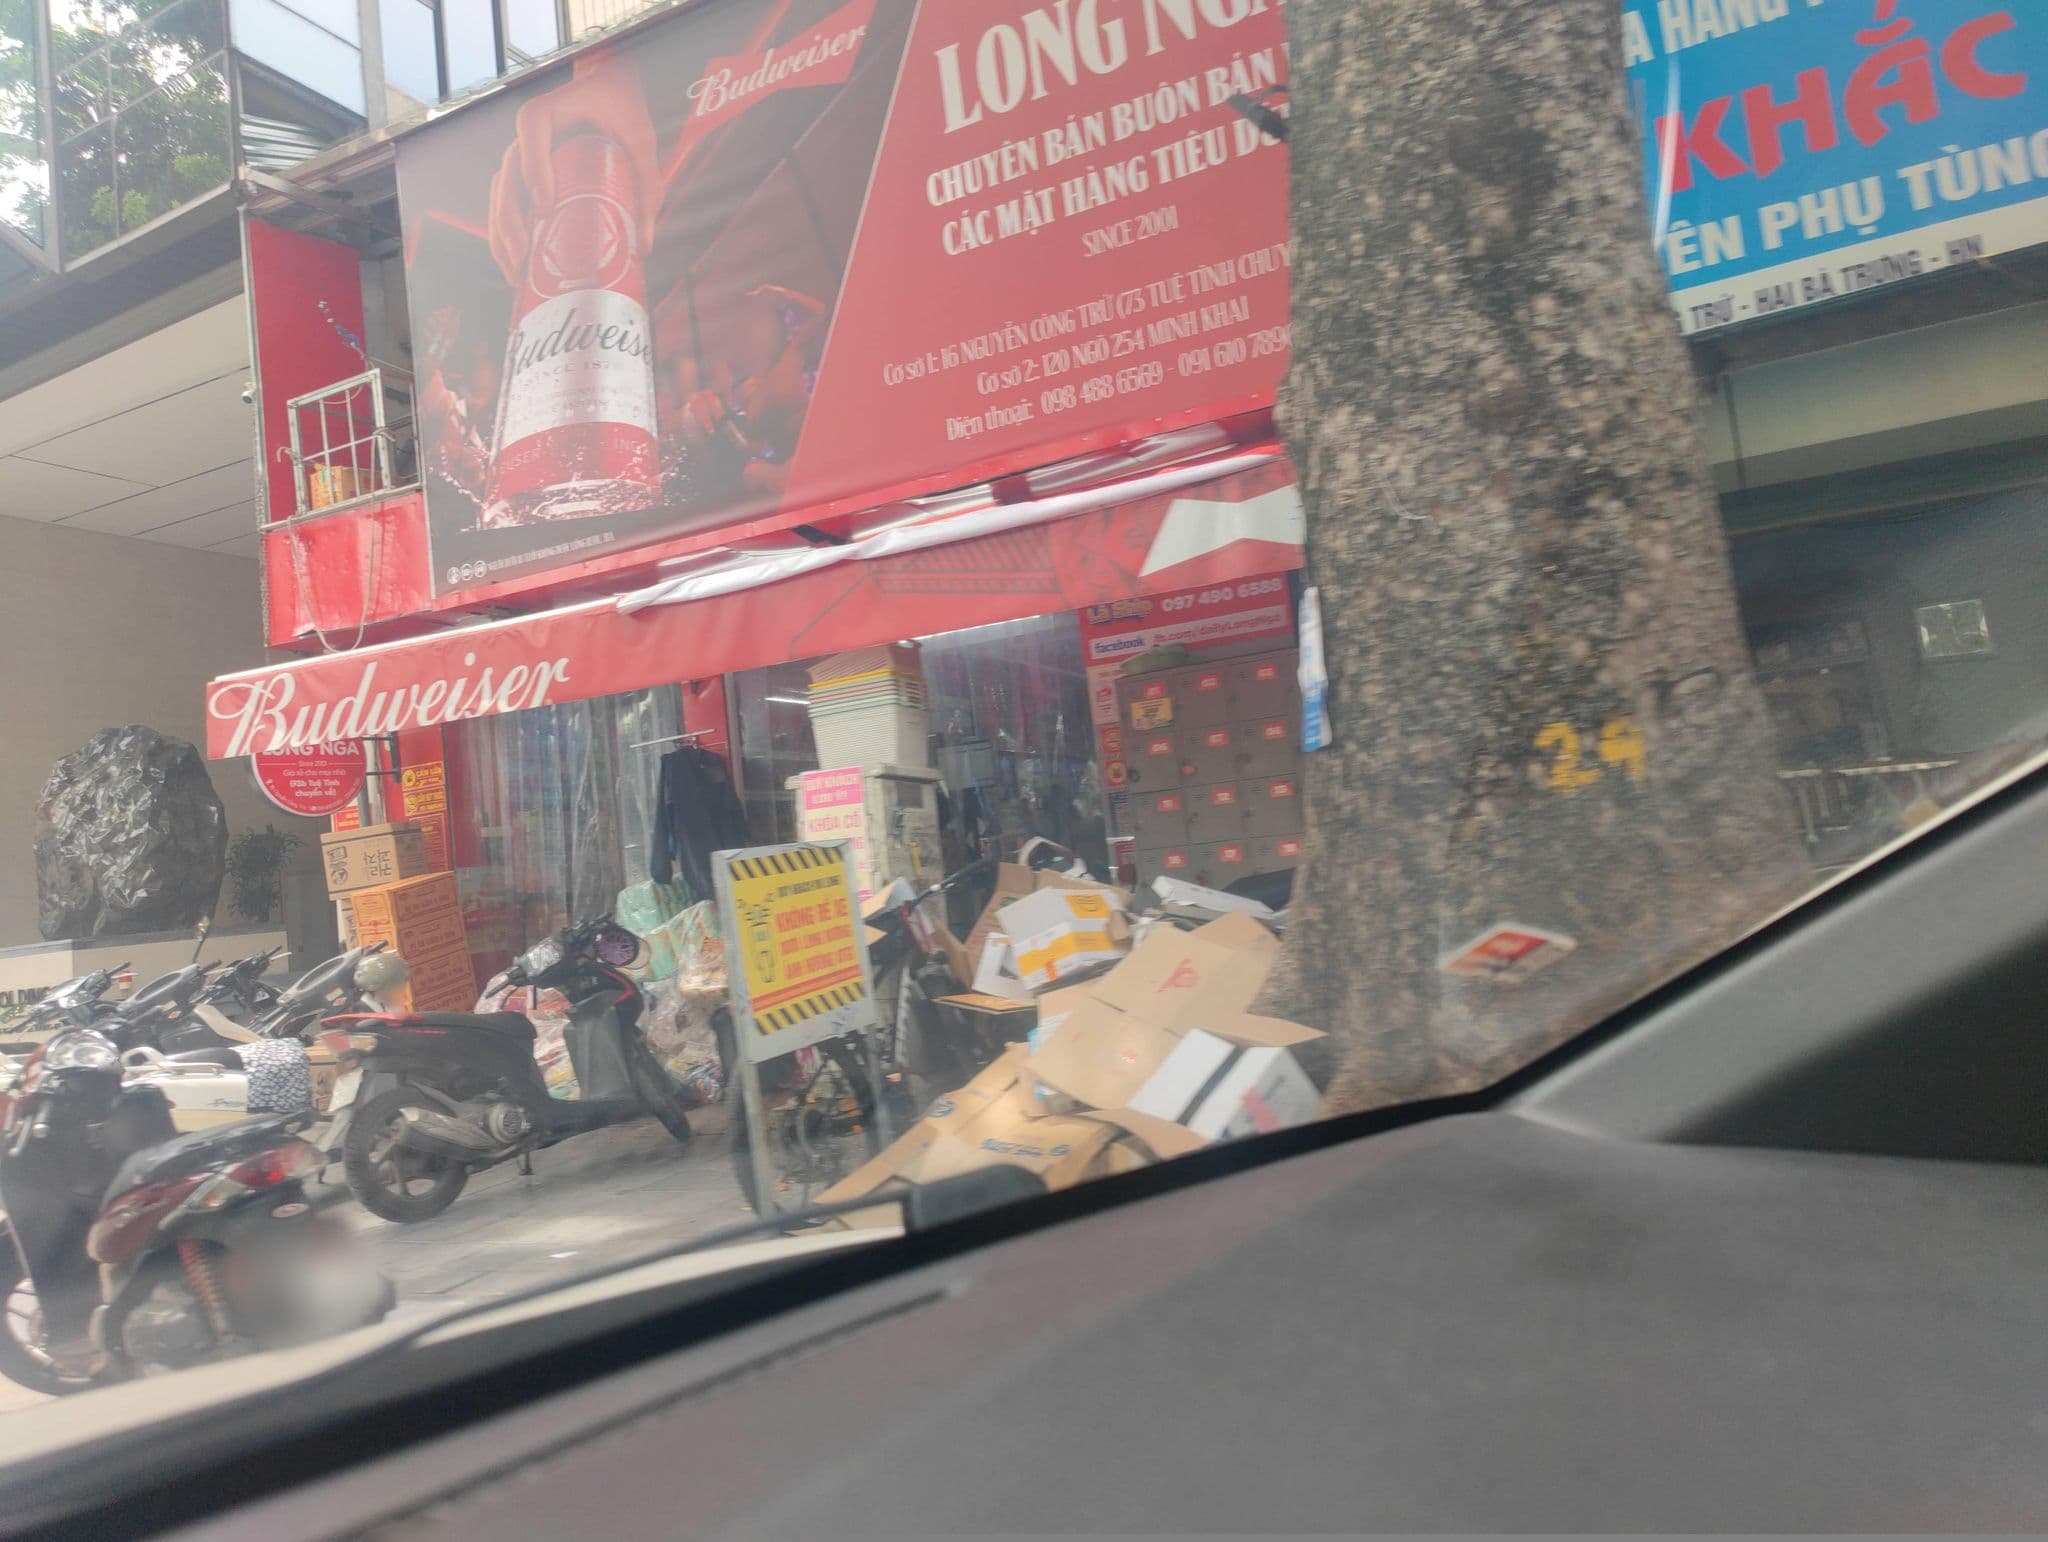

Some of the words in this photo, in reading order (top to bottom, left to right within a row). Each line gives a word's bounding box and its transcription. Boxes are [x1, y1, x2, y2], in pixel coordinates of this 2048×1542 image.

[686, 25, 867, 117] Budweiser
[935, 0, 1129, 133] LONG
[1654, 0, 2028, 193] KHẮC
[926, 137, 1039, 207] CHUYÊN
[1111, 75, 1201, 142] BUÔN
[943, 207, 994, 256] CÁC
[996, 186, 1057, 236] MẶT
[1151, 126, 1229, 184] TIÊU
[1082, 220, 1136, 257] SINCE
[1758, 176, 1886, 251] PHỤ
[208, 652, 571, 760] Budweiser
